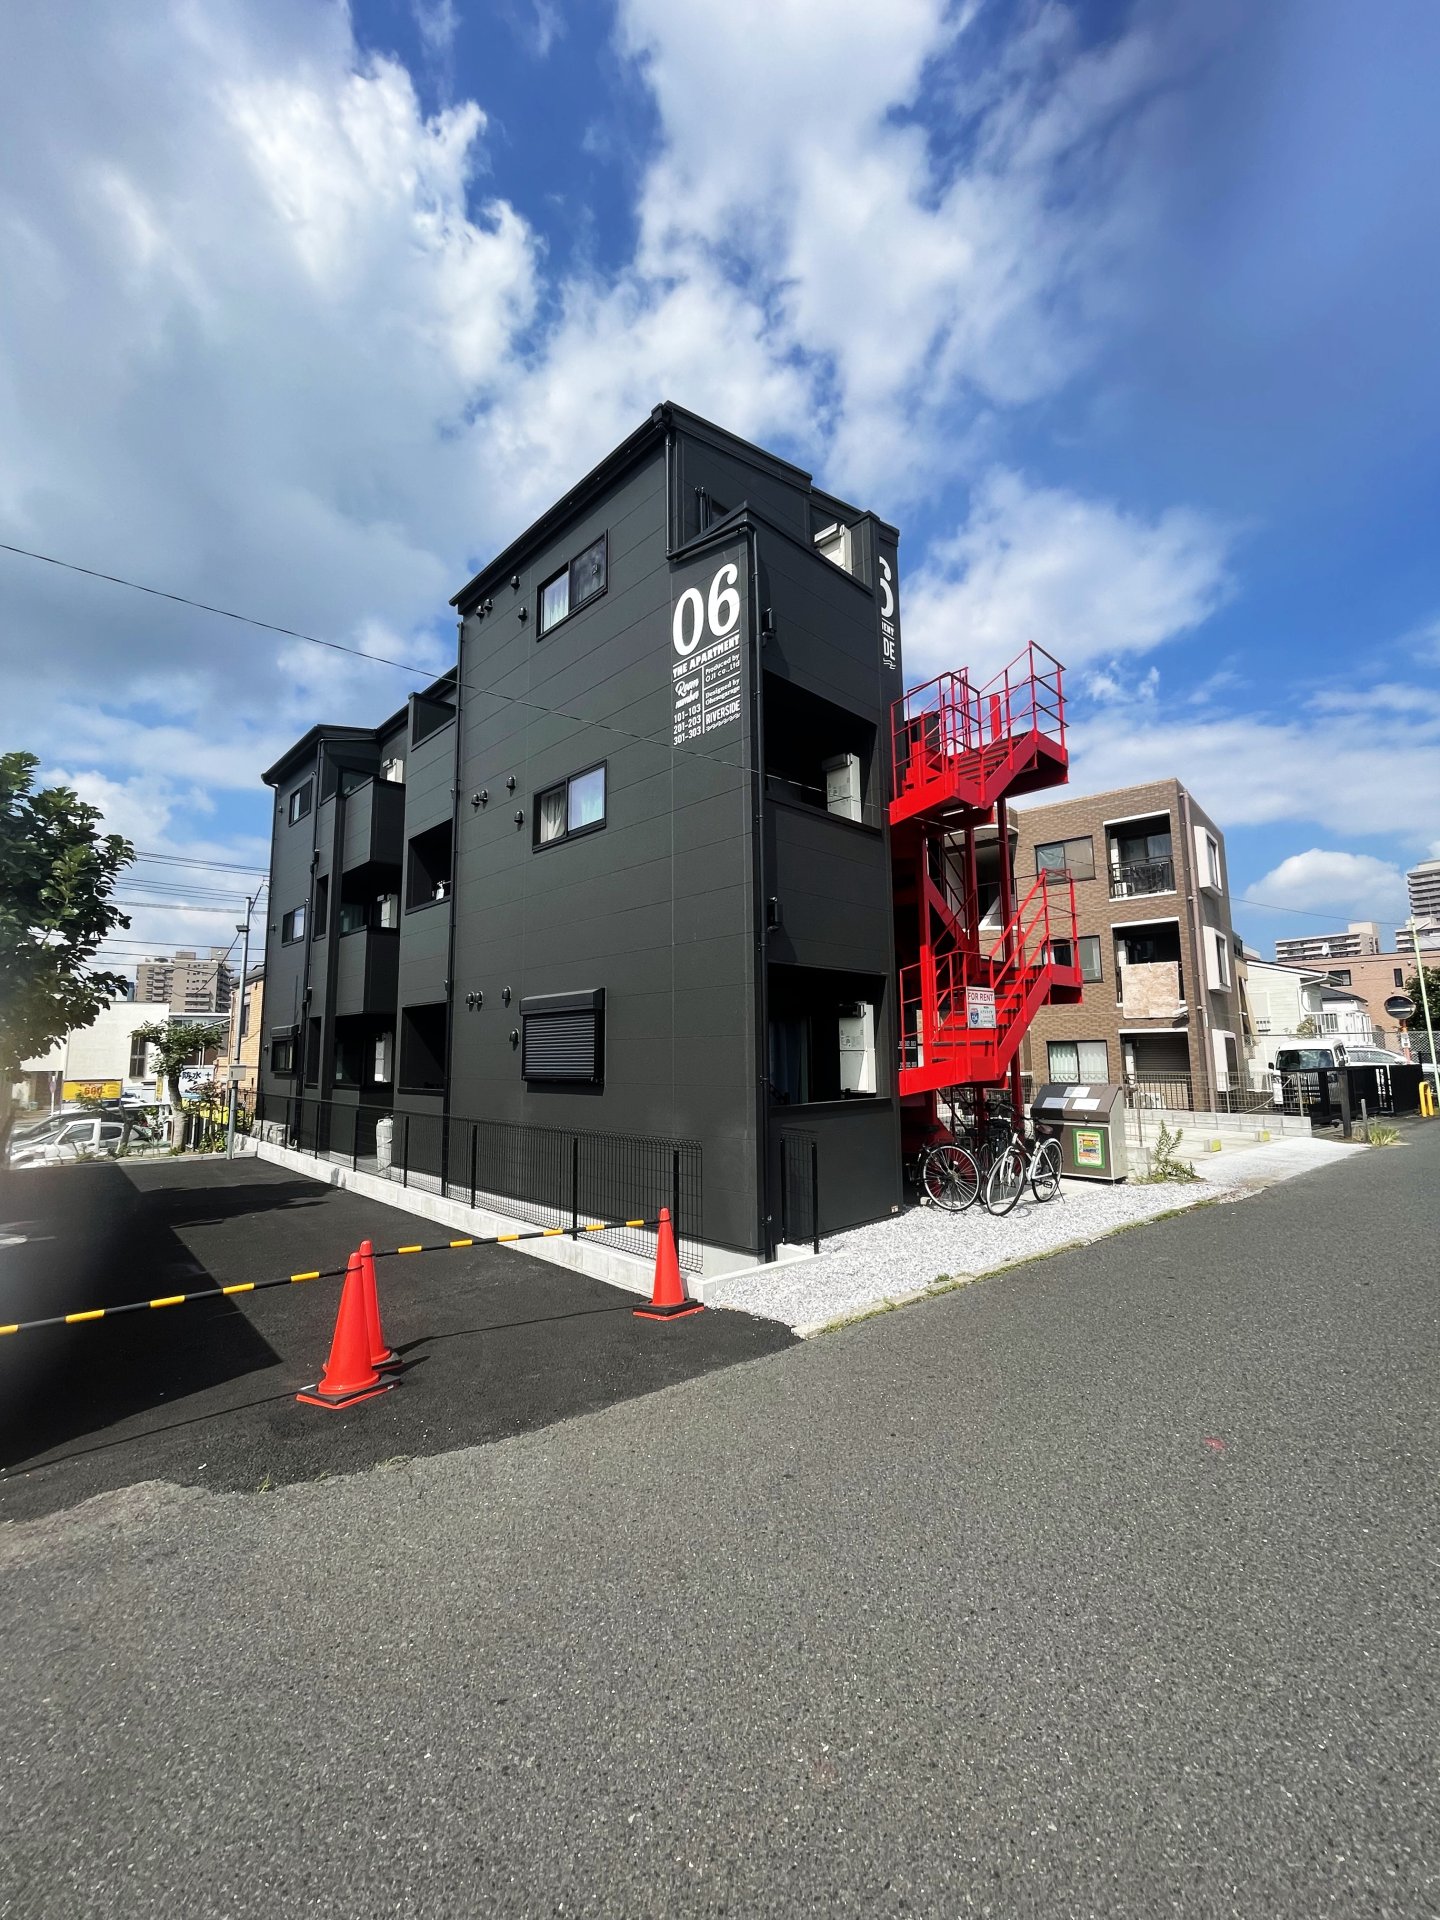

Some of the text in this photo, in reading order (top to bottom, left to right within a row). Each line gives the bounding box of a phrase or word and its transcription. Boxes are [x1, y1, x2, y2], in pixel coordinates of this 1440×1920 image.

[673, 564, 740, 656] 06
[672, 634, 740, 678] THE APARTMENT
[705, 653, 740, 675] Produced by
[705, 672, 716, 682] OJI
[675, 678, 699, 697] Room
[705, 680, 732, 699] Designed
[674, 703, 701, 723] 101-103
[705, 700, 740, 725] RIVERSIDE
[673, 714, 701, 734] 201-203
[673, 726, 701, 745] 301-303
[968, 992, 993, 1001] FOR RENT
